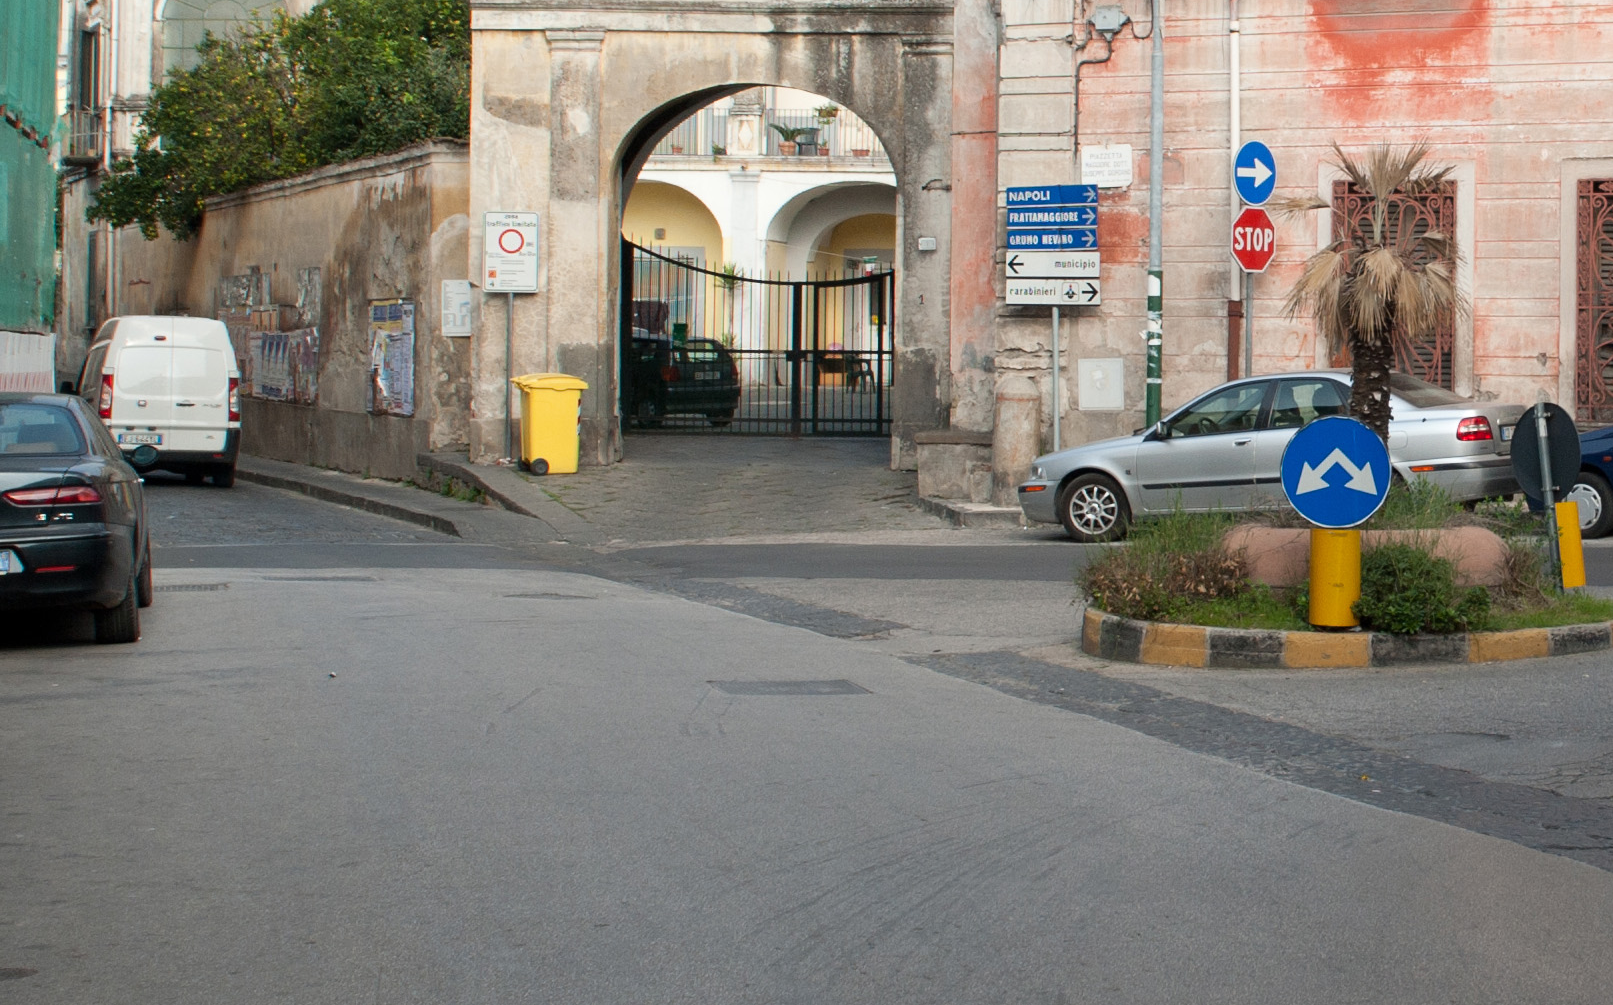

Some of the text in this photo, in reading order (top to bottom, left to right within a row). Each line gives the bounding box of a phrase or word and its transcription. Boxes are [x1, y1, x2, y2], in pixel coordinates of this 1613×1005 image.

[1008, 190, 1051, 202] NAPOLI
[1009, 211, 1079, 223] FRATTAMAGGIORE
[1009, 235, 1039, 245] GRUMO
[1234, 226, 1273, 252] STOP
[1054, 258, 1096, 270] municipio
[1009, 286, 1056, 296] carabinieri
[918, 294, 925, 305] 1
